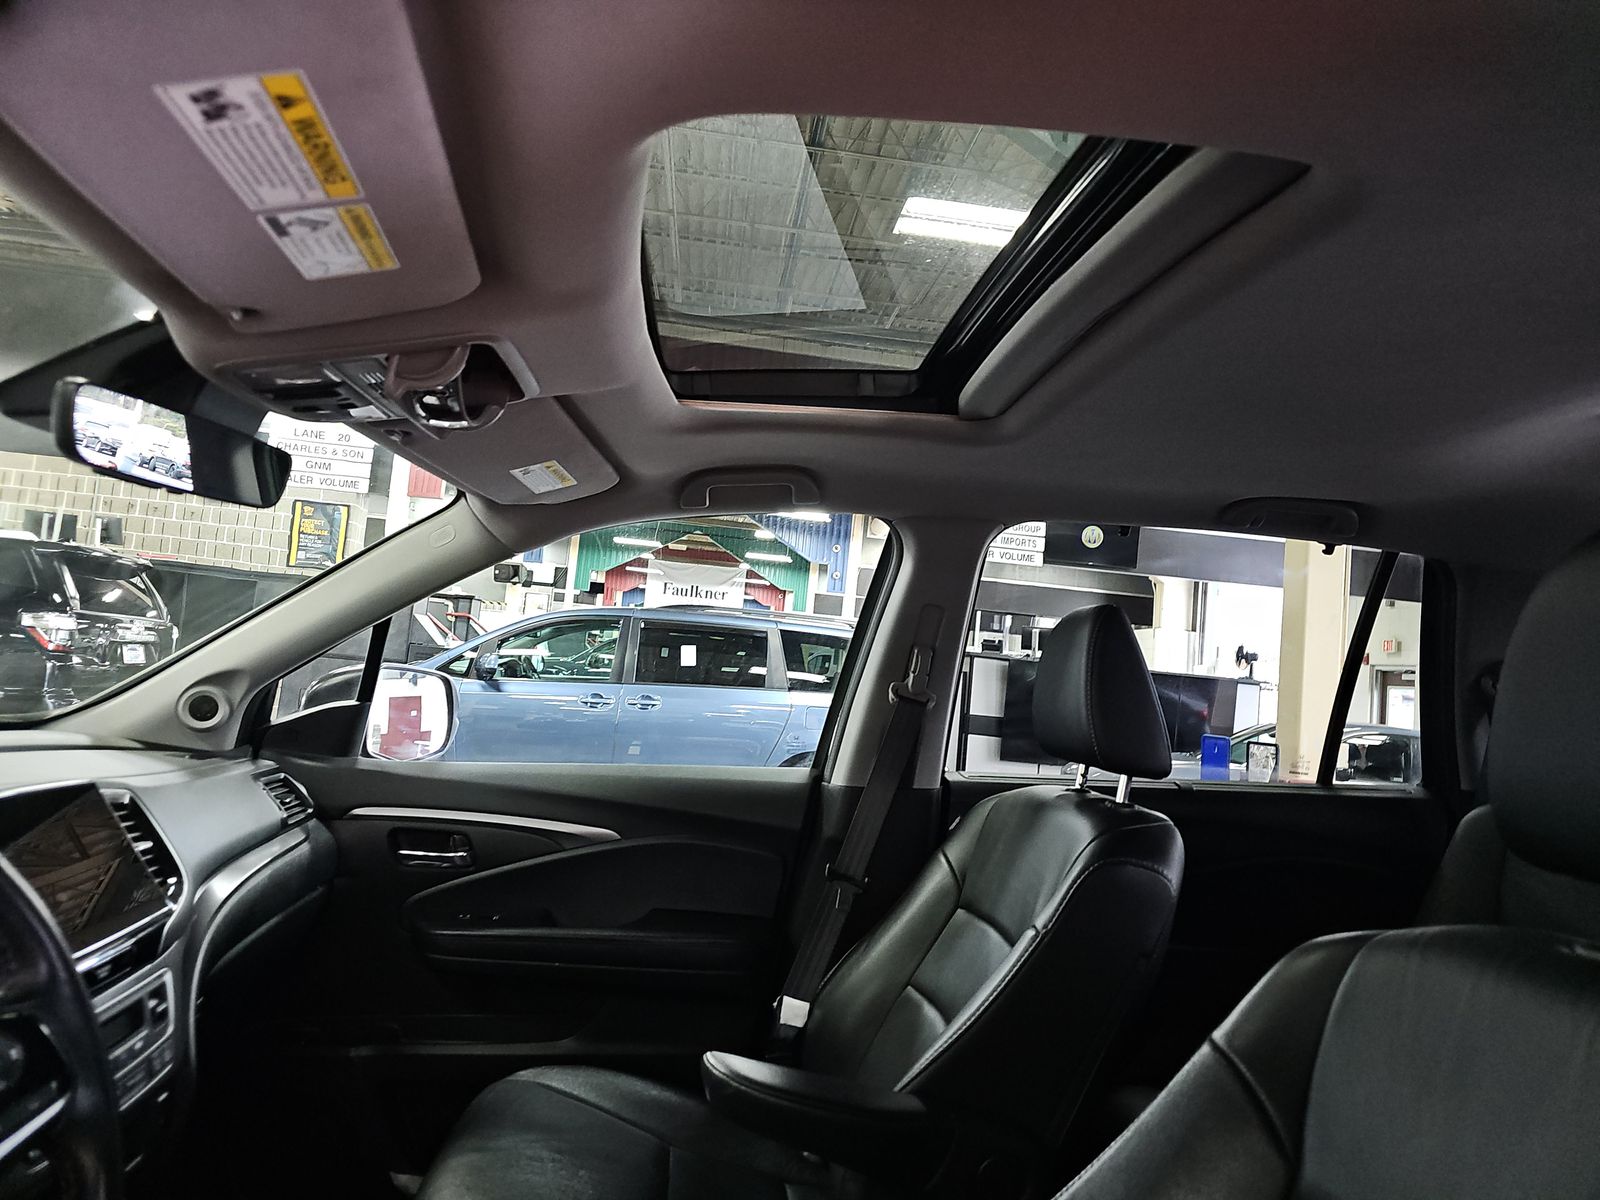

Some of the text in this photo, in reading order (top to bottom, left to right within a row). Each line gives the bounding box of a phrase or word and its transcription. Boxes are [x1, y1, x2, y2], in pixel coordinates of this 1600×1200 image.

[293, 428, 351, 443] LANE 20
[277, 441, 364, 459] CHARLES & SON
[305, 460, 332, 471] GNM
[287, 474, 360, 490] ALER VOLUME
[1012, 523, 1041, 534] GROUP
[1000, 536, 1037, 549] IMPORTS
[999, 551, 1036, 563] VOLUME
[663, 582, 729, 600] Faulkner
